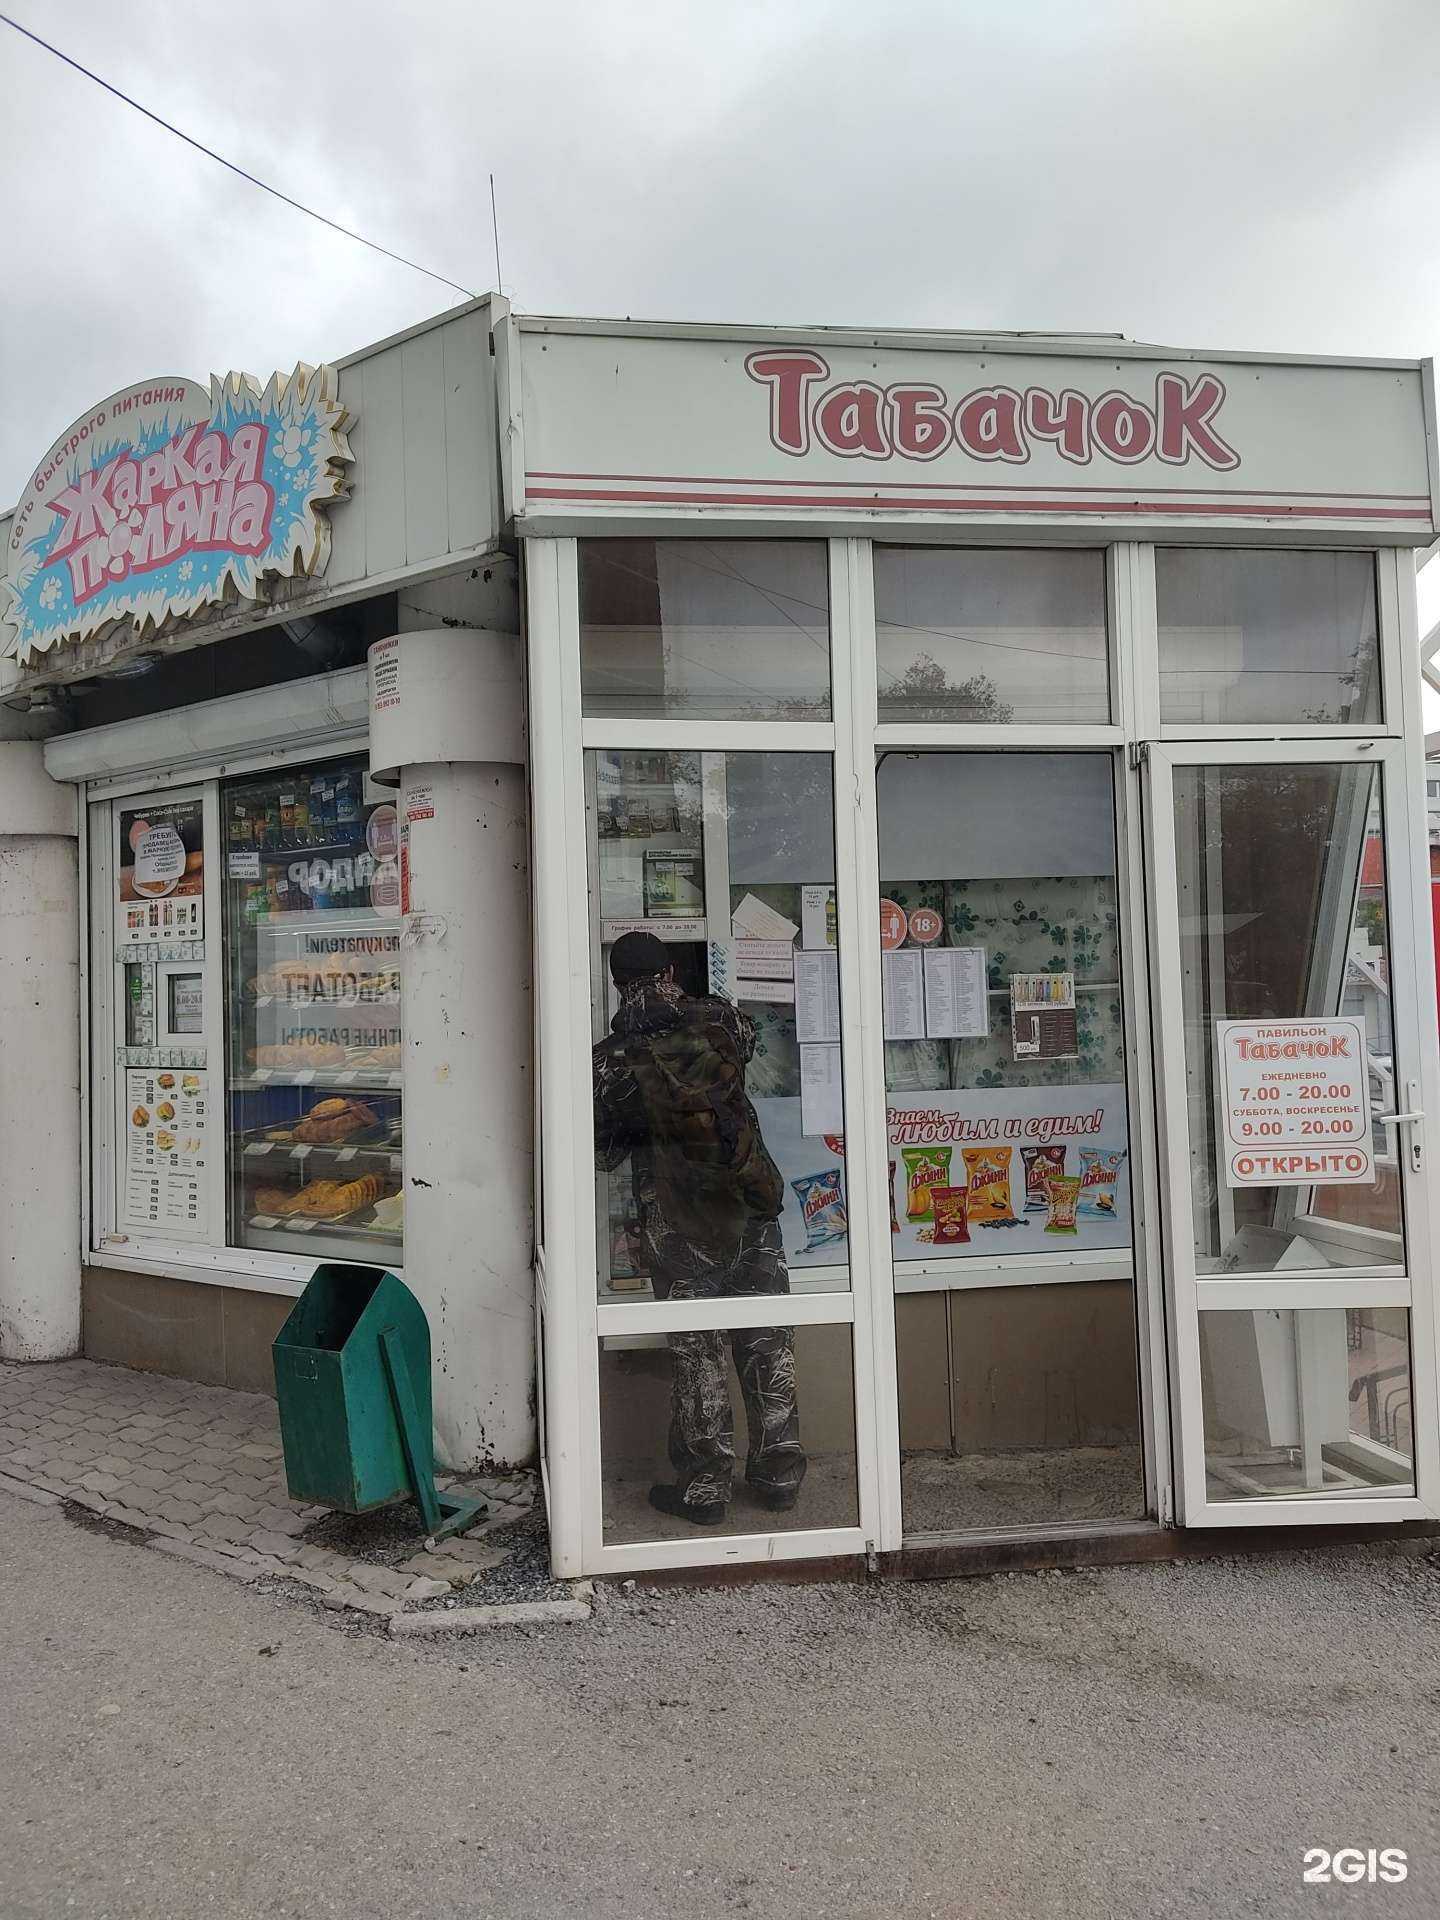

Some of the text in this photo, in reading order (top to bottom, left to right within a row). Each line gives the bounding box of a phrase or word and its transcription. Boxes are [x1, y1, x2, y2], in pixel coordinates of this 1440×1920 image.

[11, 387, 185, 550] сеть быстрого питания
[915, 918, 937, 932] 18+
[1257, 1028, 1327, 1038] ПАВИЛЬОН
[1262, 1072, 1327, 1081] ЕЖЕДНЕВНО
[1240, 1087, 1280, 1101] 7.00
[1299, 1084, 1351, 1099] 20.00
[887, 1107, 944, 1127] Знаем,
[1233, 1105, 1360, 1117] СУББОТА, ВОСКРЕСЕНЬЕ
[890, 1108, 1104, 1144] любим и едим!
[1241, 1122, 1282, 1136] 9.00
[1300, 1119, 1353, 1135] 20.00
[1237, 1154, 1362, 1174] ОТКРЫТО
